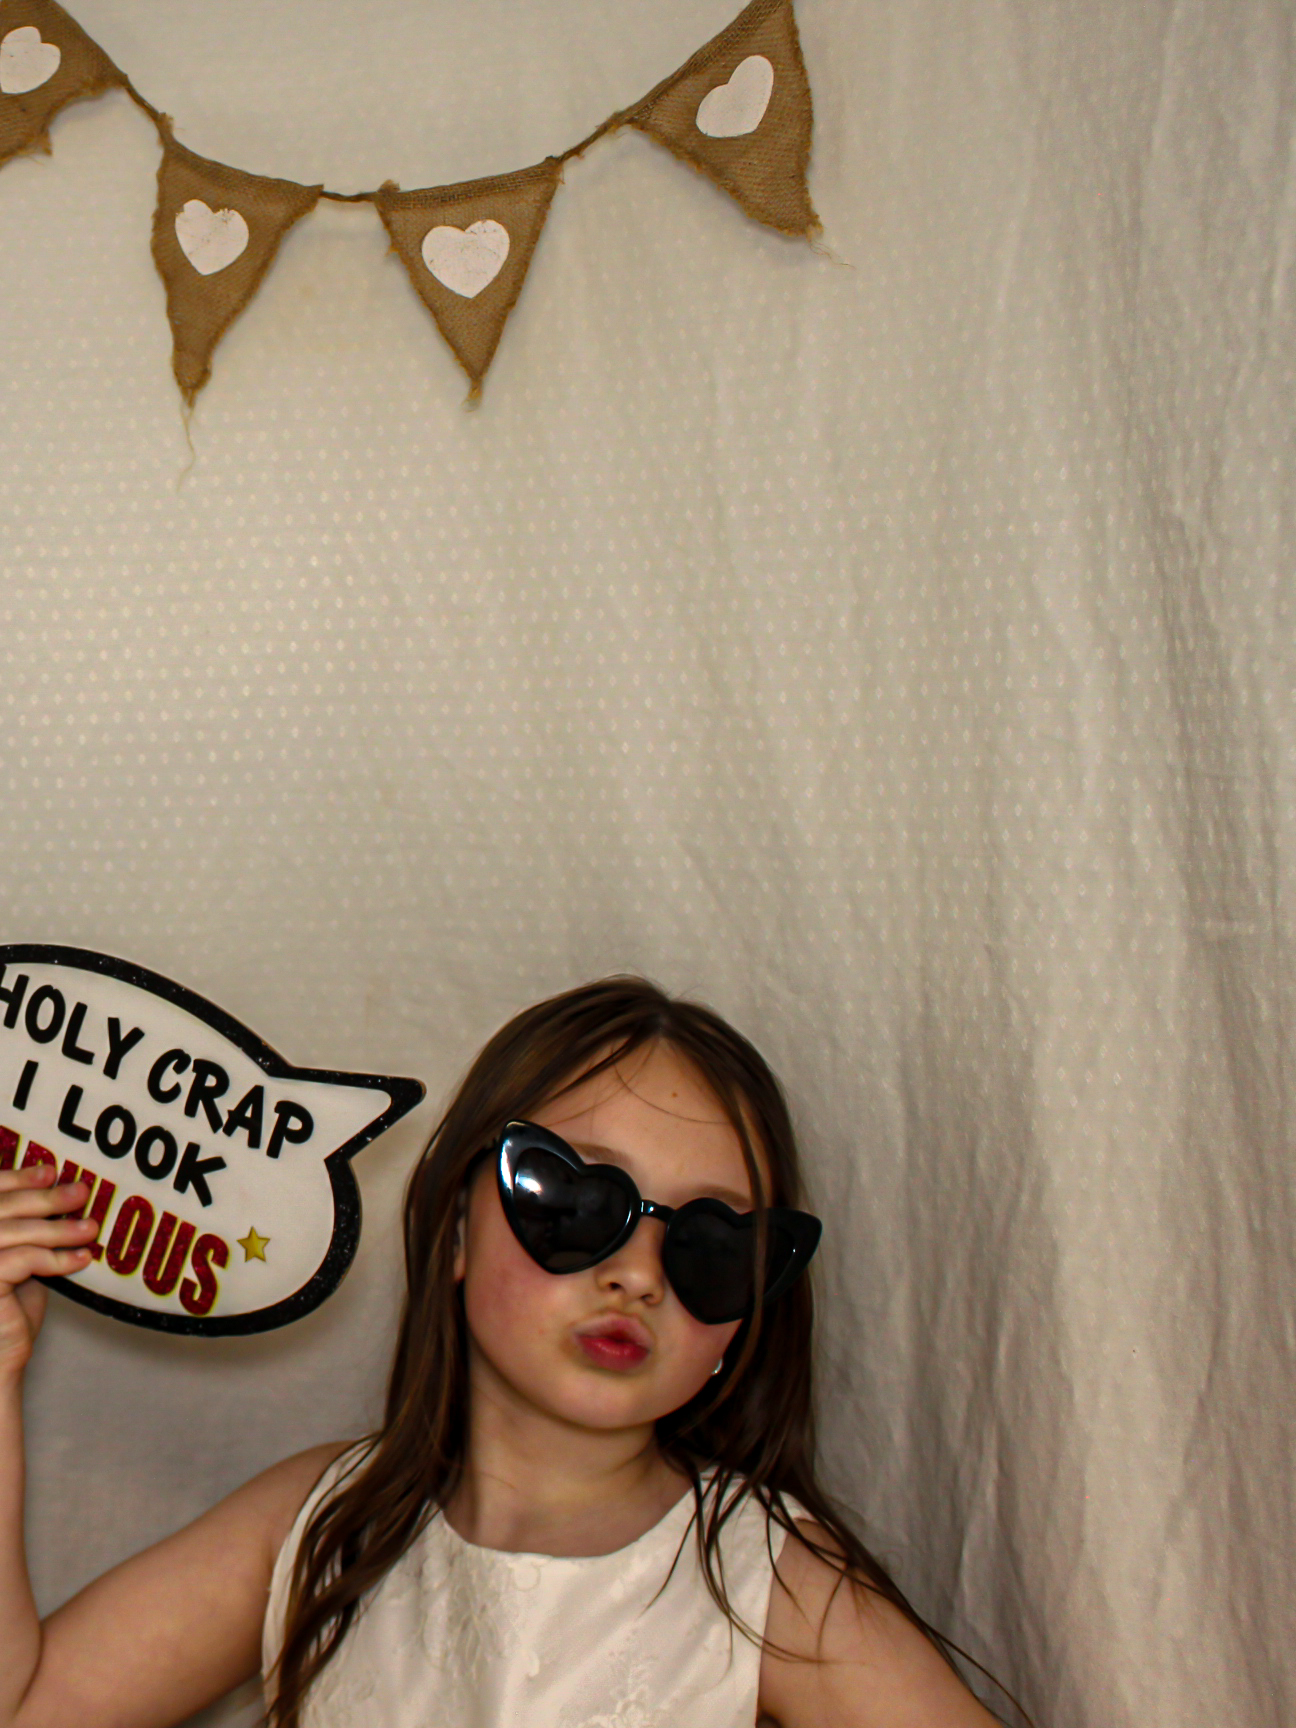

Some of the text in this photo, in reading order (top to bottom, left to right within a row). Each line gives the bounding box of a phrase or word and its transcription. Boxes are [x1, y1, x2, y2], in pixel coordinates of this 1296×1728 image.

[12, 1059, 227, 1208] I LOOK
[147, 1048, 314, 1159] CRAP
